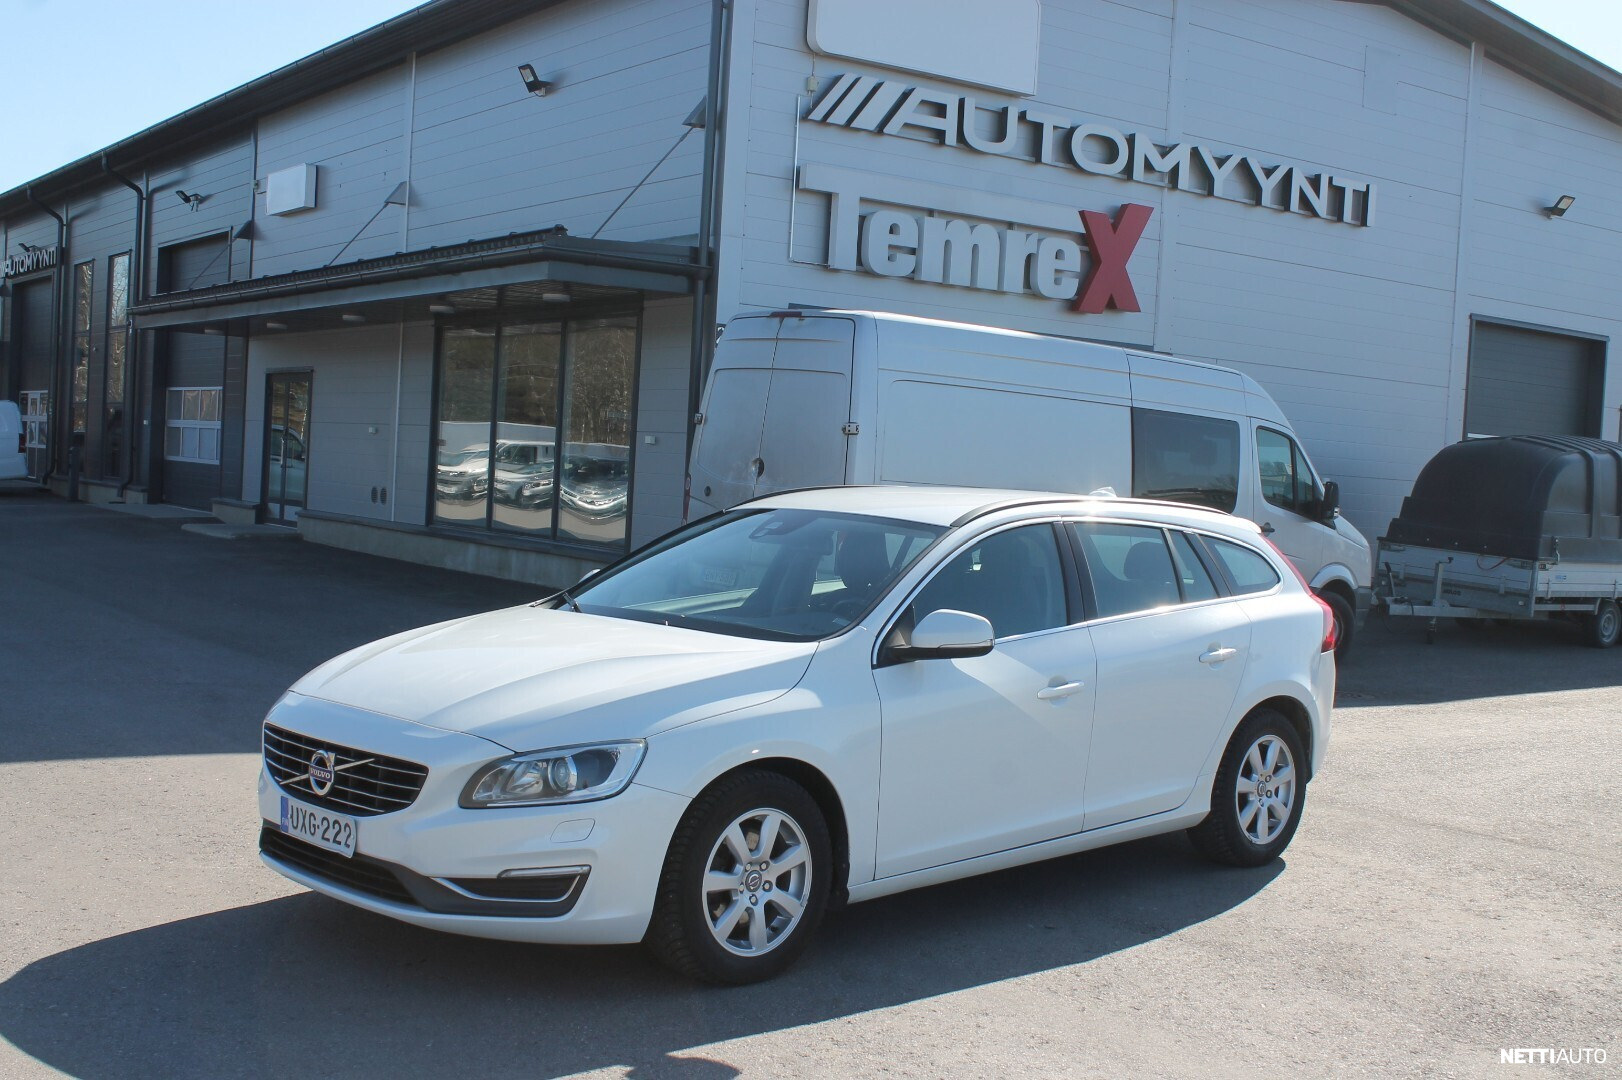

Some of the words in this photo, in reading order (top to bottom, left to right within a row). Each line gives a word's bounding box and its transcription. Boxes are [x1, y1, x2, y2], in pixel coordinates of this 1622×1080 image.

[882, 86, 1377, 228] AUTOMYYNTI
[5, 247, 57, 277] AUTOMYYNTI
[310, 767, 331, 779] VOLVO
[289, 804, 353, 849] UXG-222
